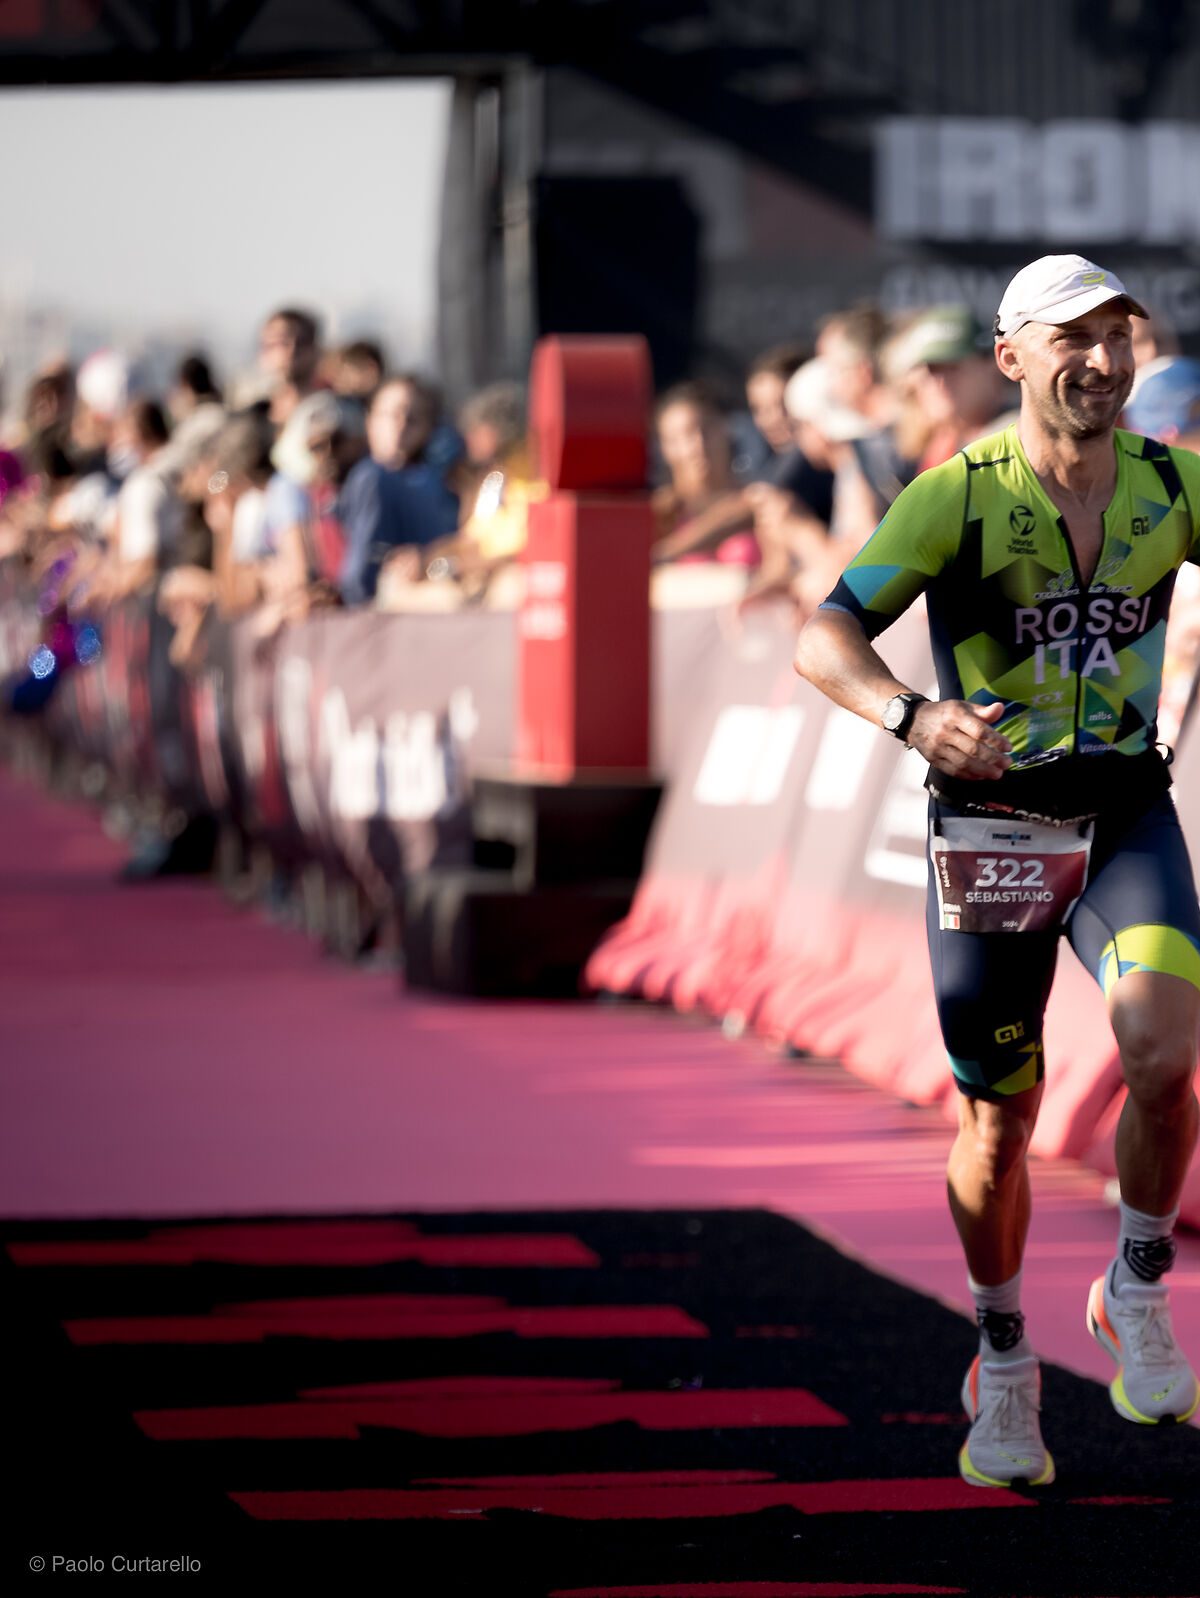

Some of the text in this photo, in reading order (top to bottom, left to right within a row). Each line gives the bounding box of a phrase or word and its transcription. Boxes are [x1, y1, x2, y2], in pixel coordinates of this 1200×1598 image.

[1015, 596, 1151, 644] ROSSI
[1034, 637, 1121, 685] ITA
[975, 858, 1045, 888] 322
[965, 891, 1054, 903] SEBASTIANO
